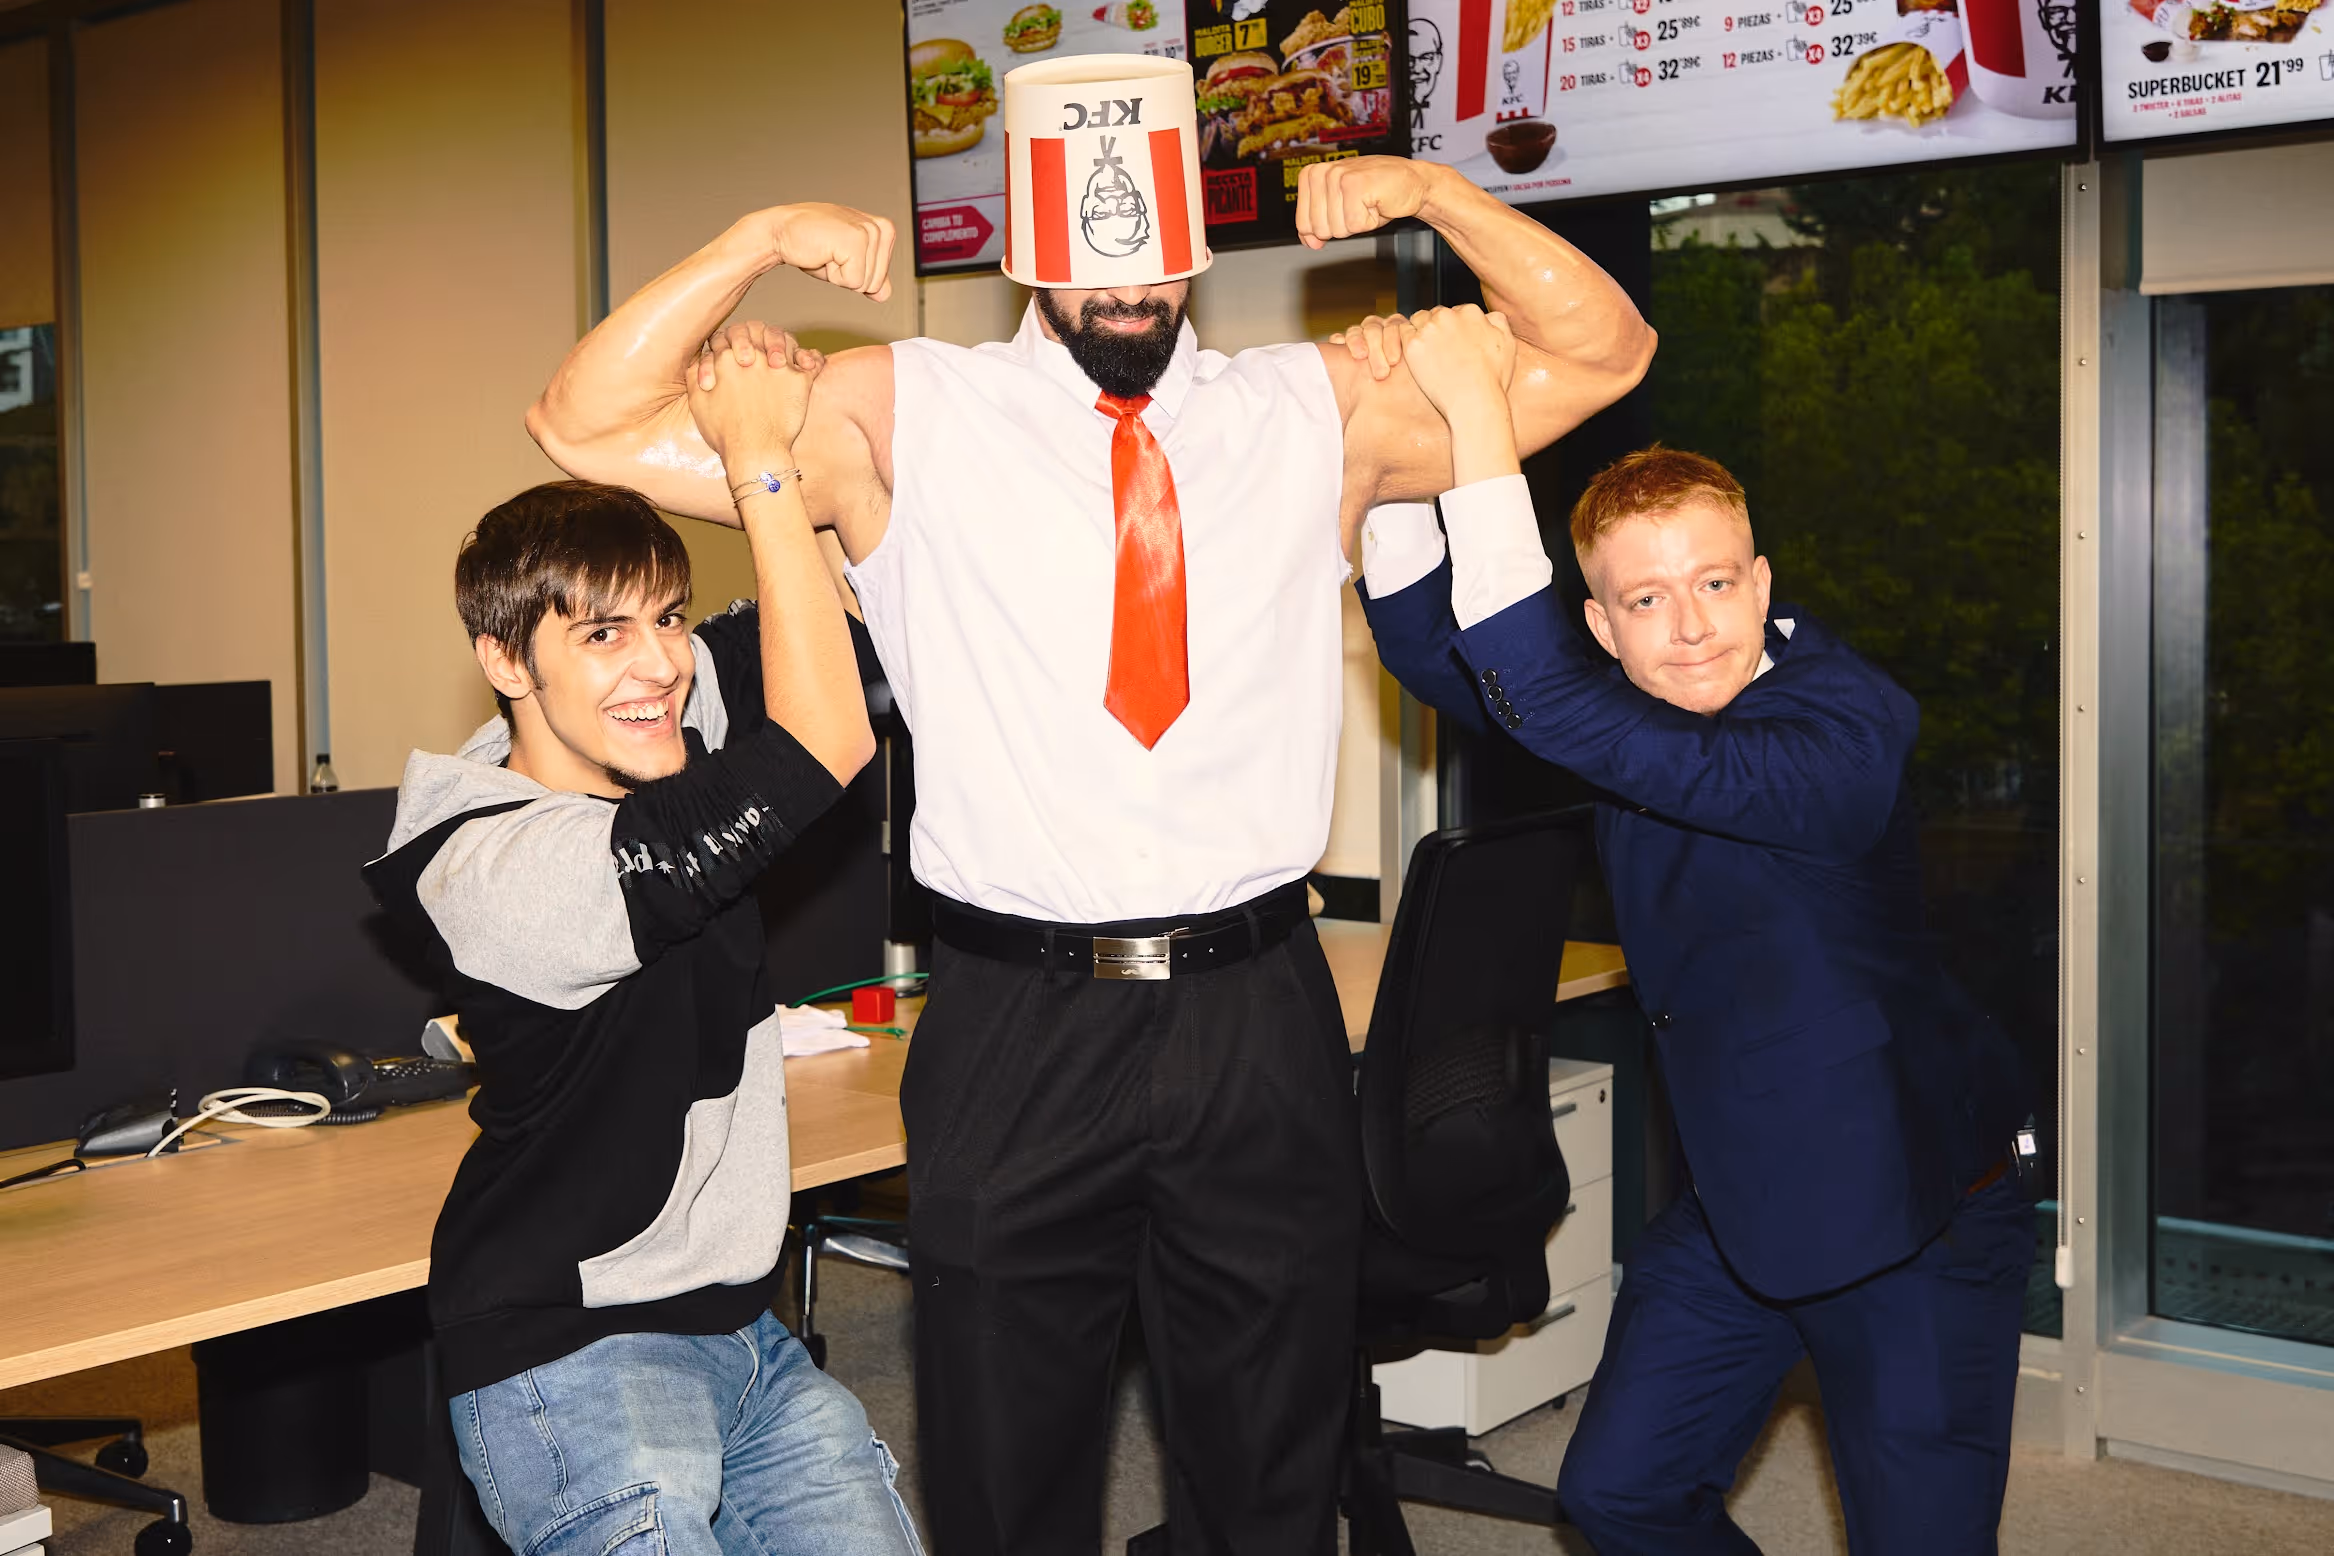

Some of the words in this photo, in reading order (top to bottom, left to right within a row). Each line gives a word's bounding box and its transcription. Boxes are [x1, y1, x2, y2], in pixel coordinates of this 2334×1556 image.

[1561, 1, 1575, 16] 12
[1579, 0, 1605, 12] TIRAS
[1350, 4, 1386, 34] CUBO
[1724, 16, 1733, 32] 9
[1737, 13, 1771, 28] PIEZAS
[1562, 37, 1576, 53] 15
[1579, 35, 1606, 49] TIRAS
[1722, 52, 1737, 69] 12
[1740, 50, 1774, 65] PIEZAS
[1560, 74, 1576, 91] 20
[1580, 73, 1606, 87] TIRAS
[2128, 68, 2246, 99] SUPERBUCKET
[1063, 98, 1143, 130] KFC
